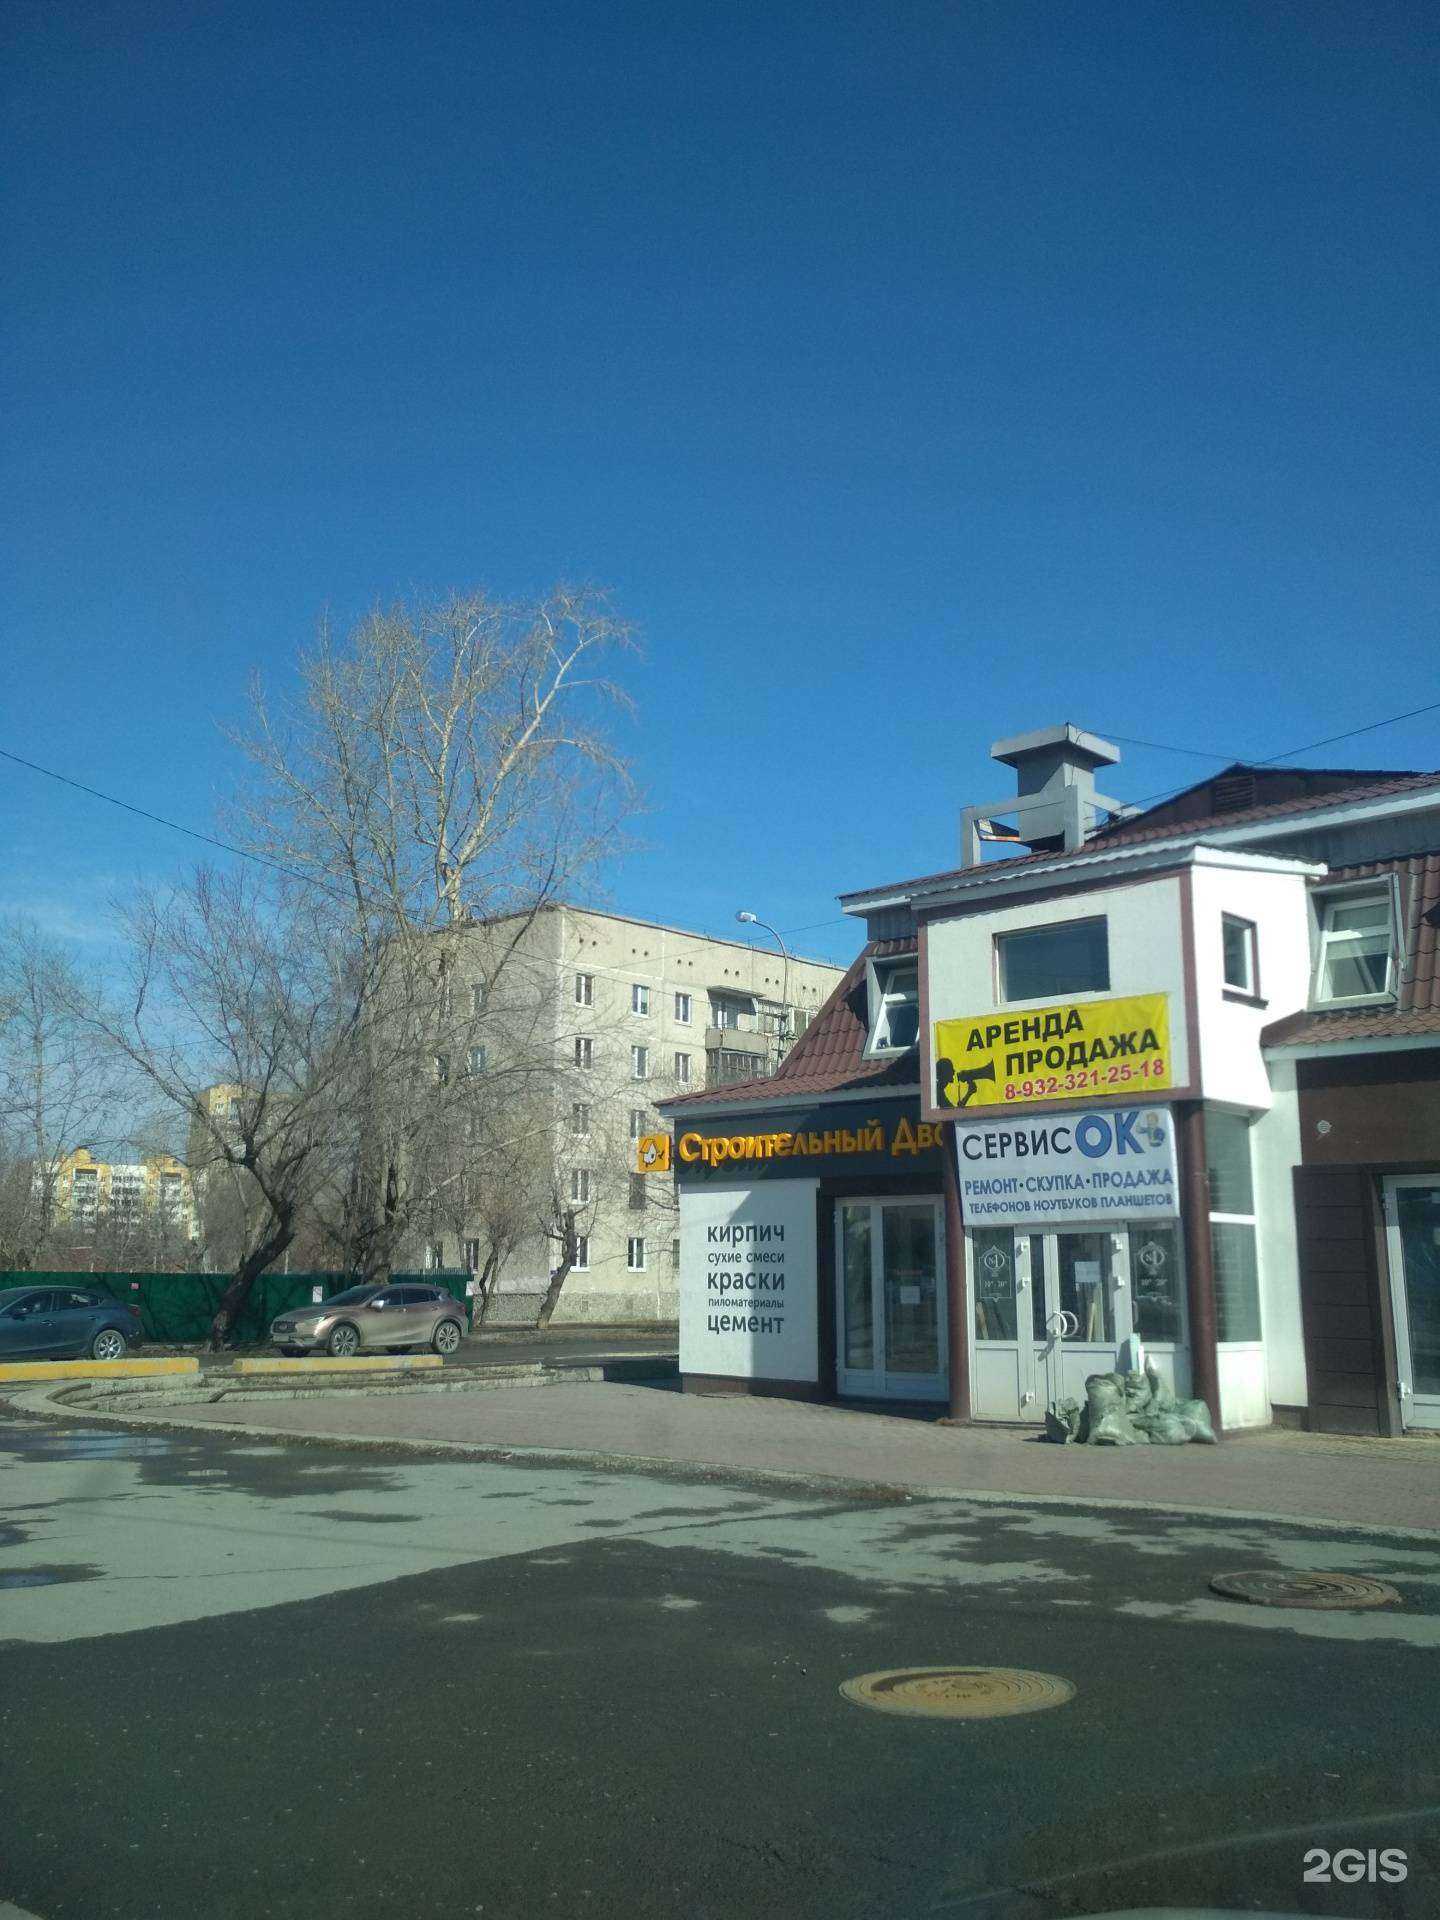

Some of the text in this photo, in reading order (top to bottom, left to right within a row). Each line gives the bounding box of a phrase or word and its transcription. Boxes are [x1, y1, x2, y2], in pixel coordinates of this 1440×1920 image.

[966, 1009, 1084, 1051] АРЕНДА
[1005, 1028, 1160, 1076] ПРОДАЖА
[1004, 1058, 1164, 1100] 8-932-321-25-18
[679, 1118, 884, 1167] Строительный
[969, 1193, 1173, 1214] ТЕЛЕФОНОВ НОУТБУКОВ ПЛАНШЕТОВ
[707, 1224, 785, 1248] кирпич
[707, 1252, 785, 1266] сухие смеси
[707, 1272, 785, 1295] краски
[708, 1298, 784, 1310] пиломатериалы
[707, 1314, 785, 1335] цемент
